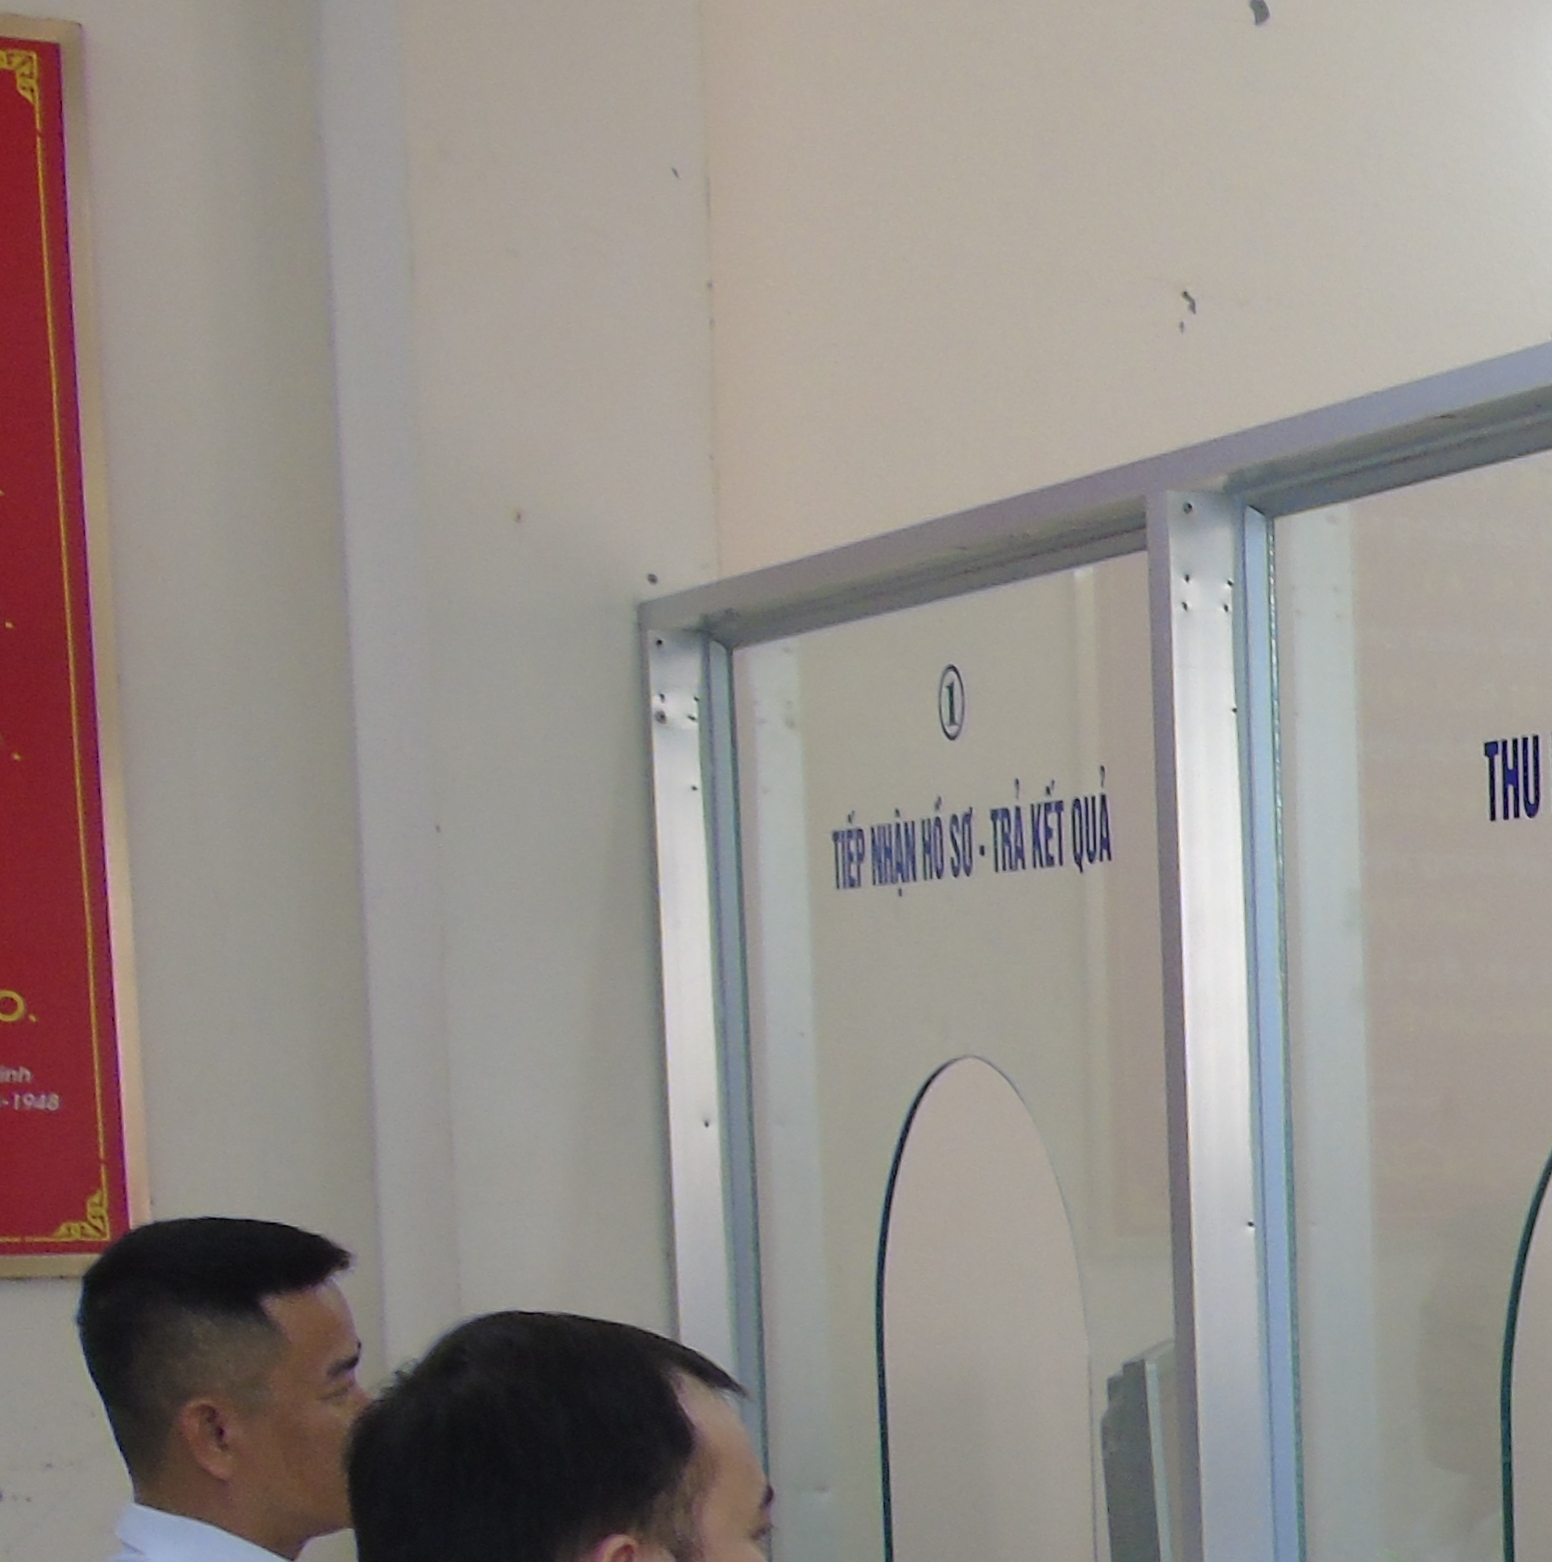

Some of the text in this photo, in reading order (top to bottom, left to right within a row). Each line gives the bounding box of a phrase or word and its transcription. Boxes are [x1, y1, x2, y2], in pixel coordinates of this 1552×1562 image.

[832, 809, 865, 890] TIẾP
[871, 807, 917, 898] NHẬN
[949, 806, 973, 879] SƠ
[990, 778, 1026, 873] TRẢ
[1030, 779, 1064, 870] KẾT
[1071, 765, 1112, 874] QUẢ
[1484, 735, 1540, 822] THU
